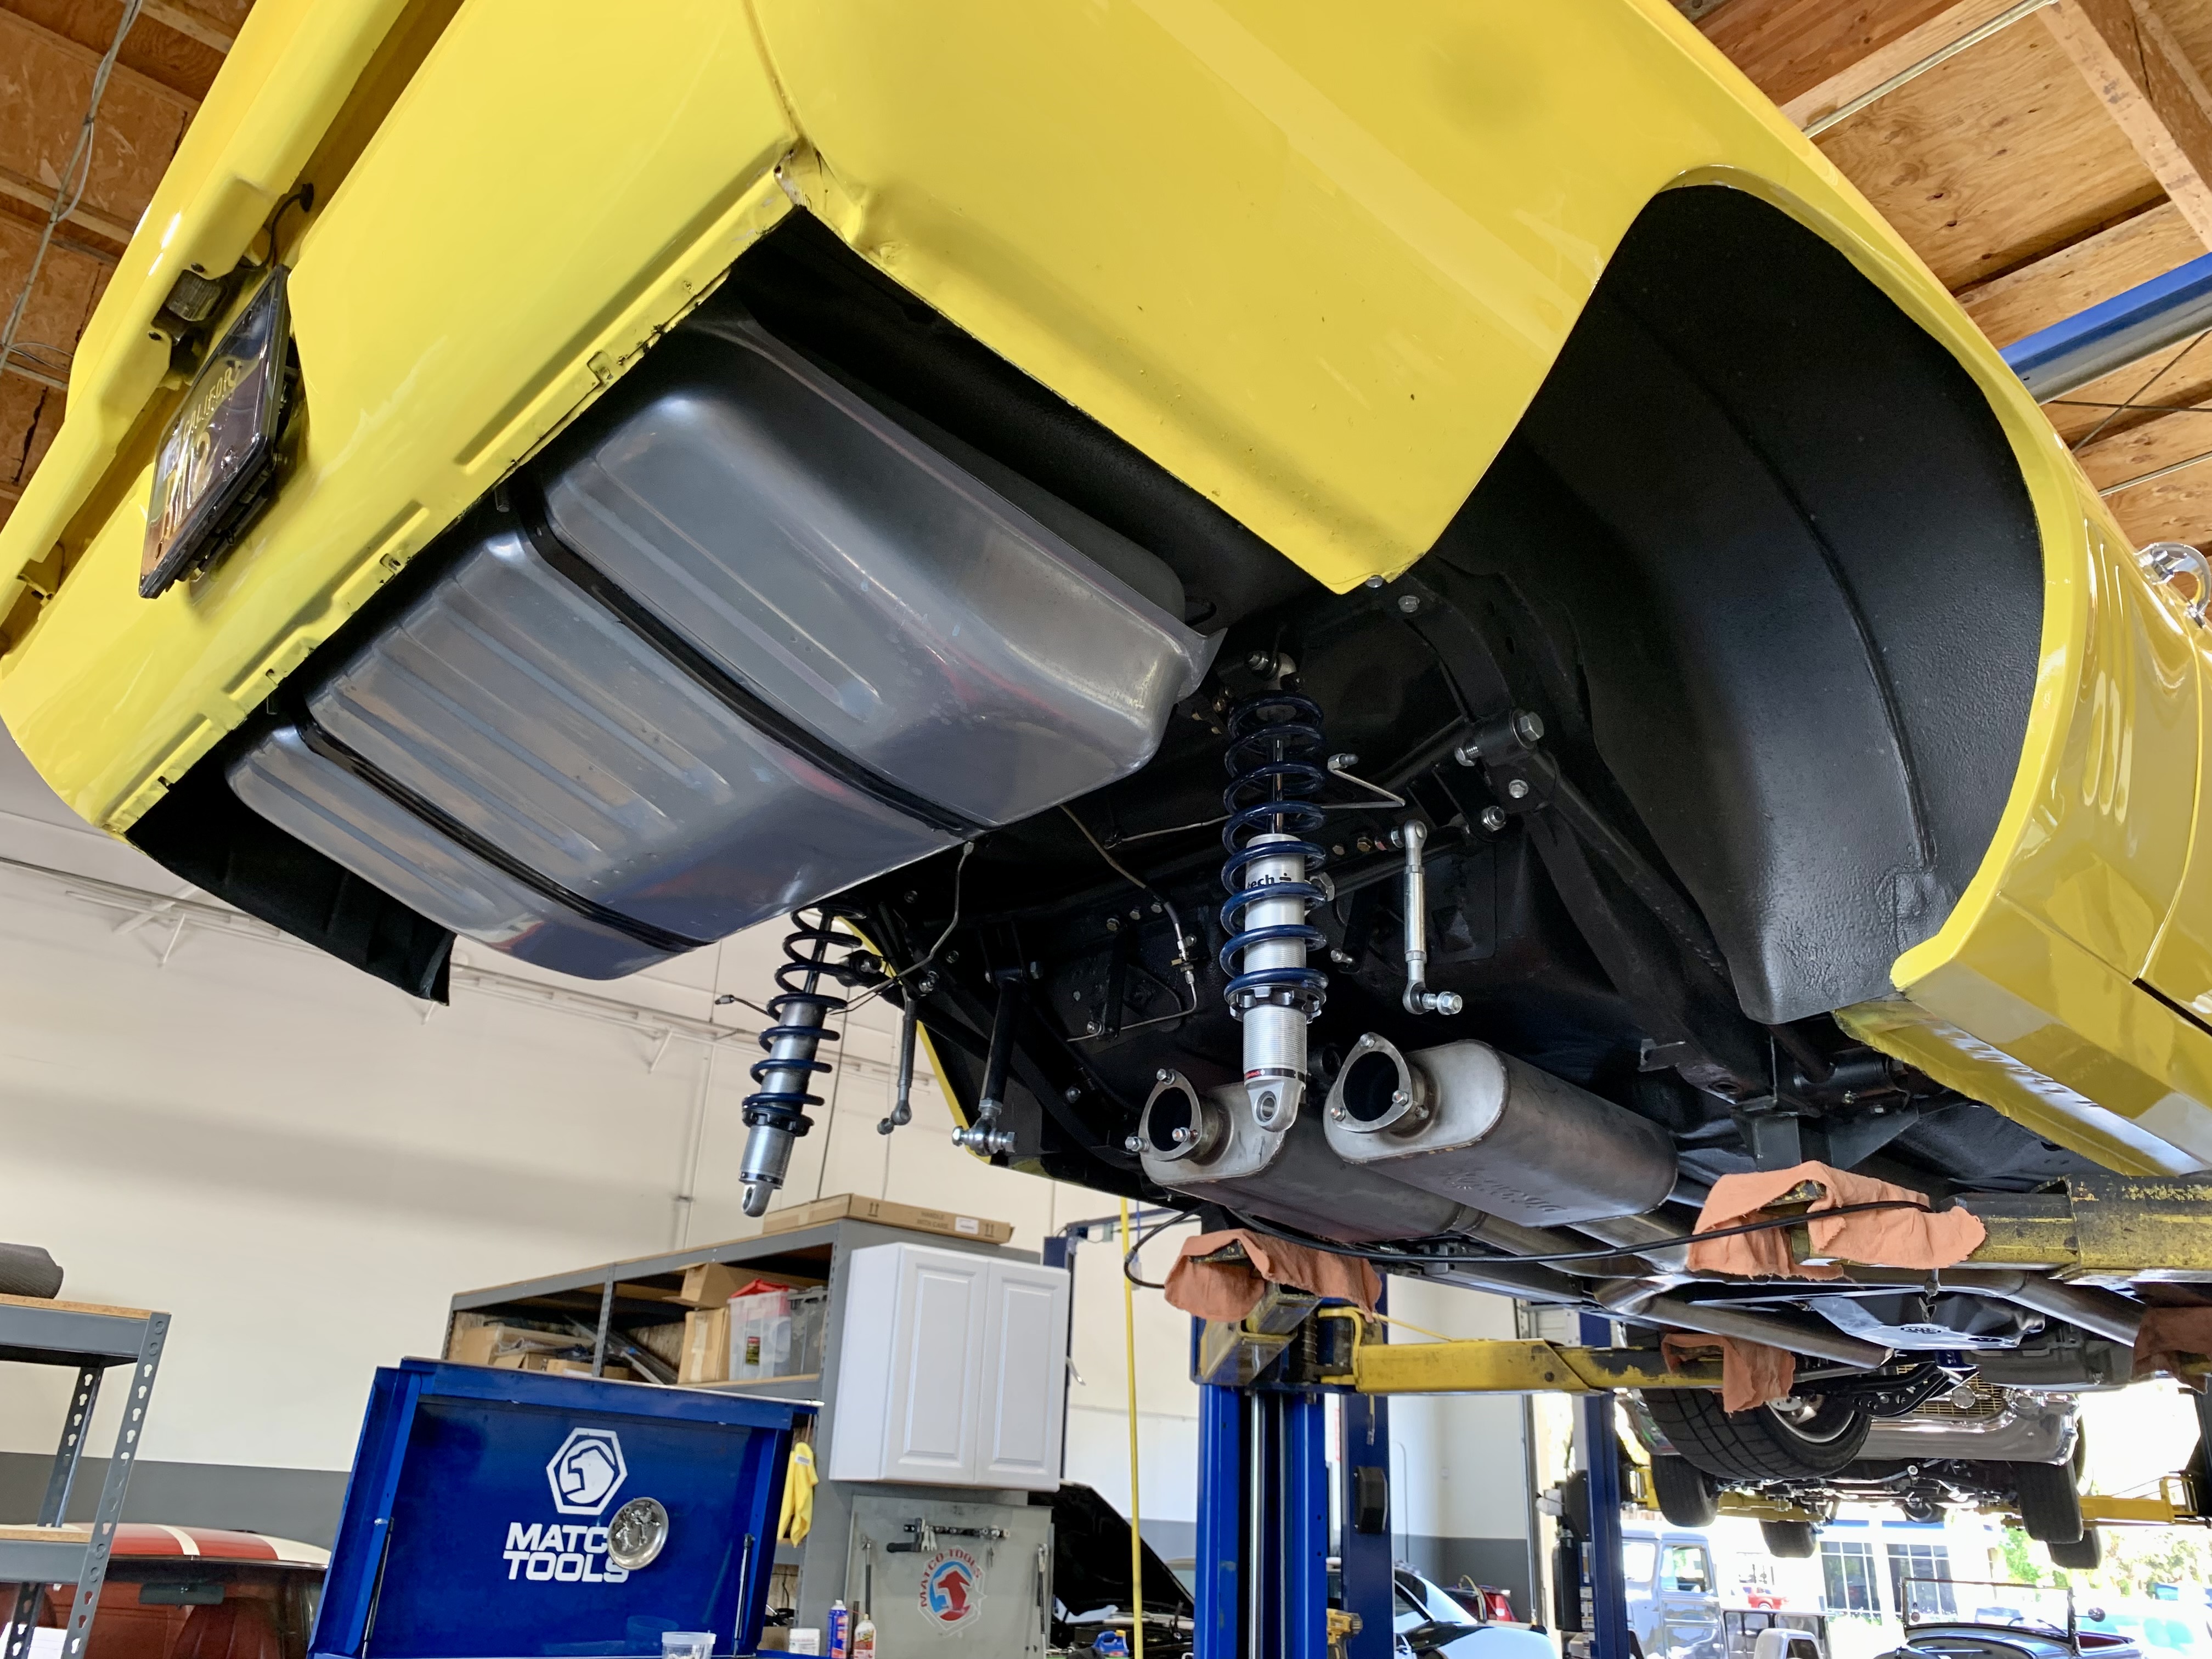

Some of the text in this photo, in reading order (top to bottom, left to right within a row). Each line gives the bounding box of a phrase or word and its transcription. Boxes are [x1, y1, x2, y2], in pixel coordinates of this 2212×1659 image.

[183, 362, 238, 441] CALIFOR
[505, 1522, 608, 1554] MATC
[503, 1550, 629, 1583] TOOLS
[919, 1548, 982, 1607] MATCO TOOLS
